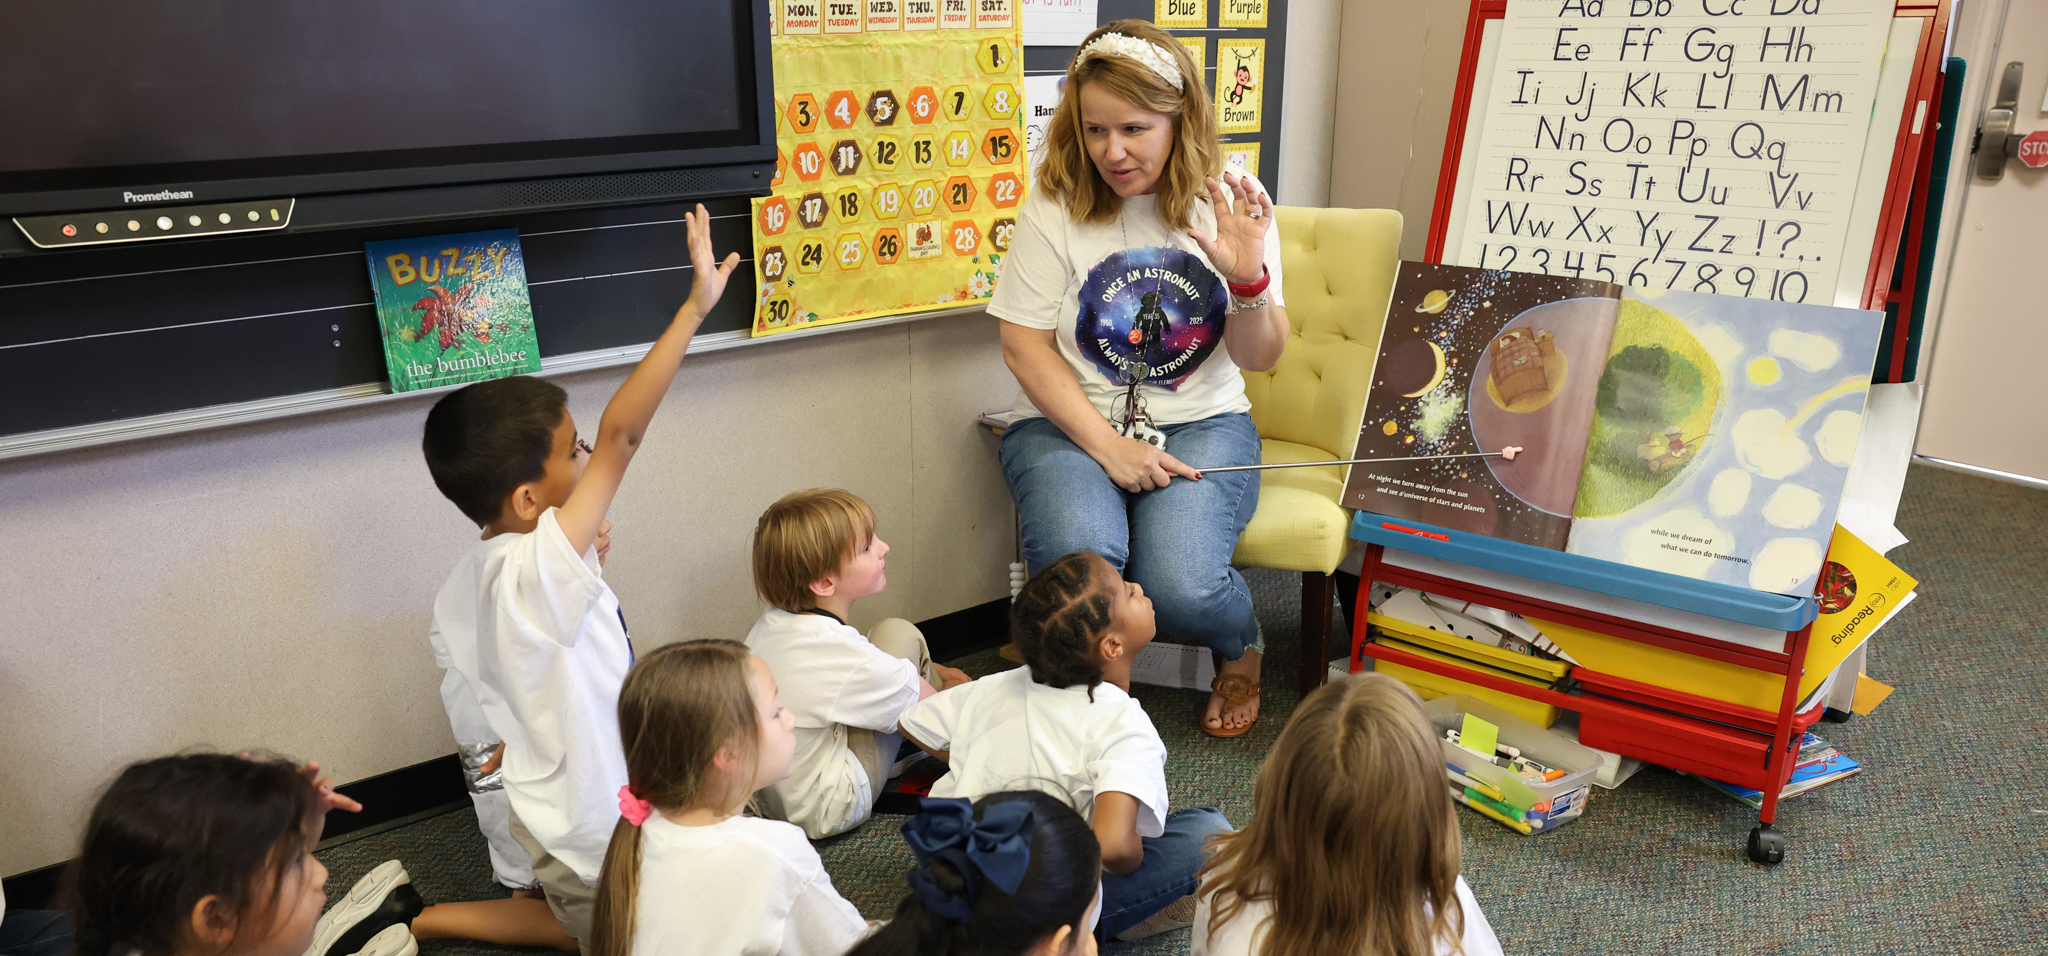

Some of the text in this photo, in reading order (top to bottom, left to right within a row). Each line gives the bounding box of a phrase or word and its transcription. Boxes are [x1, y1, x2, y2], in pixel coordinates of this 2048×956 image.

[787, 4, 818, 17] MON.
[829, 3, 857, 16] TUE.
[870, 1, 897, 13] WED.
[908, 2, 934, 13] THU.
[946, 0, 966, 11] FRI.
[981, 0, 1007, 12] SAT.
[1168, 0, 1196, 16] Blue
[1229, 0, 1262, 20] Purple
[786, 14, 1011, 28] MONDAY TUESDAY WEDNESDAY THURSDAY FRIDAY SATURDAY
[990, 44, 999, 68] 1
[1553, 26, 1814, 79] Ee Ff Gg Hh
[1511, 71, 1843, 122] Ii Jj Kk Ll Mm
[798, 90, 1009, 127] 3 4 5 6 7 8
[1034, 105, 1056, 117] Han
[1224, 107, 1255, 122] Brown
[799, 135, 1011, 175] 10 11 12 13 14 15
[1535, 115, 1791, 179] Nn Oo Pp Qq
[2022, 141, 2048, 156] STO
[1506, 157, 1814, 210] Rr Ss Tt Uu Vv
[123, 189, 194, 203] Promethean
[766, 179, 1016, 230] 16 17 18 19 20 21 22
[1487, 200, 1554, 237] Ww
[1566, 205, 1613, 243] Xx
[1636, 211, 1674, 264] Yy
[1688, 215, 1736, 254] Zz
[765, 223, 1015, 276] 23 24 25 26 28 29
[910, 244, 941, 252] THANKSGIVING
[386, 247, 509, 286] BUZZY
[1102, 267, 1200, 303] ONCE AN ASTRONAUT
[768, 299, 790, 322] 30
[1189, 316, 1203, 325] 2025
[406, 349, 527, 378] the bumblebee
[1097, 337, 1202, 377] ALWAYS ASTRONAUT
[1376, 475, 1391, 483] night
[1401, 480, 1414, 488] turn
[1415, 484, 1430, 492] away
[1431, 485, 1445, 494] from
[1446, 488, 1456, 496] the
[1376, 486, 1388, 494] and
[1403, 491, 1428, 502] universe
[1436, 498, 1450, 507] stars
[1451, 501, 1462, 509] and
[1463, 503, 1485, 513] planets
[1650, 528, 1713, 546] while we dream of
[1660, 542, 1678, 551] what
[1679, 546, 1689, 554] we
[1703, 550, 1713, 558] do
[1714, 552, 1749, 565] tomorrow.
[1790, 577, 1799, 585] 13
[1886, 576, 1898, 588] HMH
[1831, 605, 1875, 645] Reading
